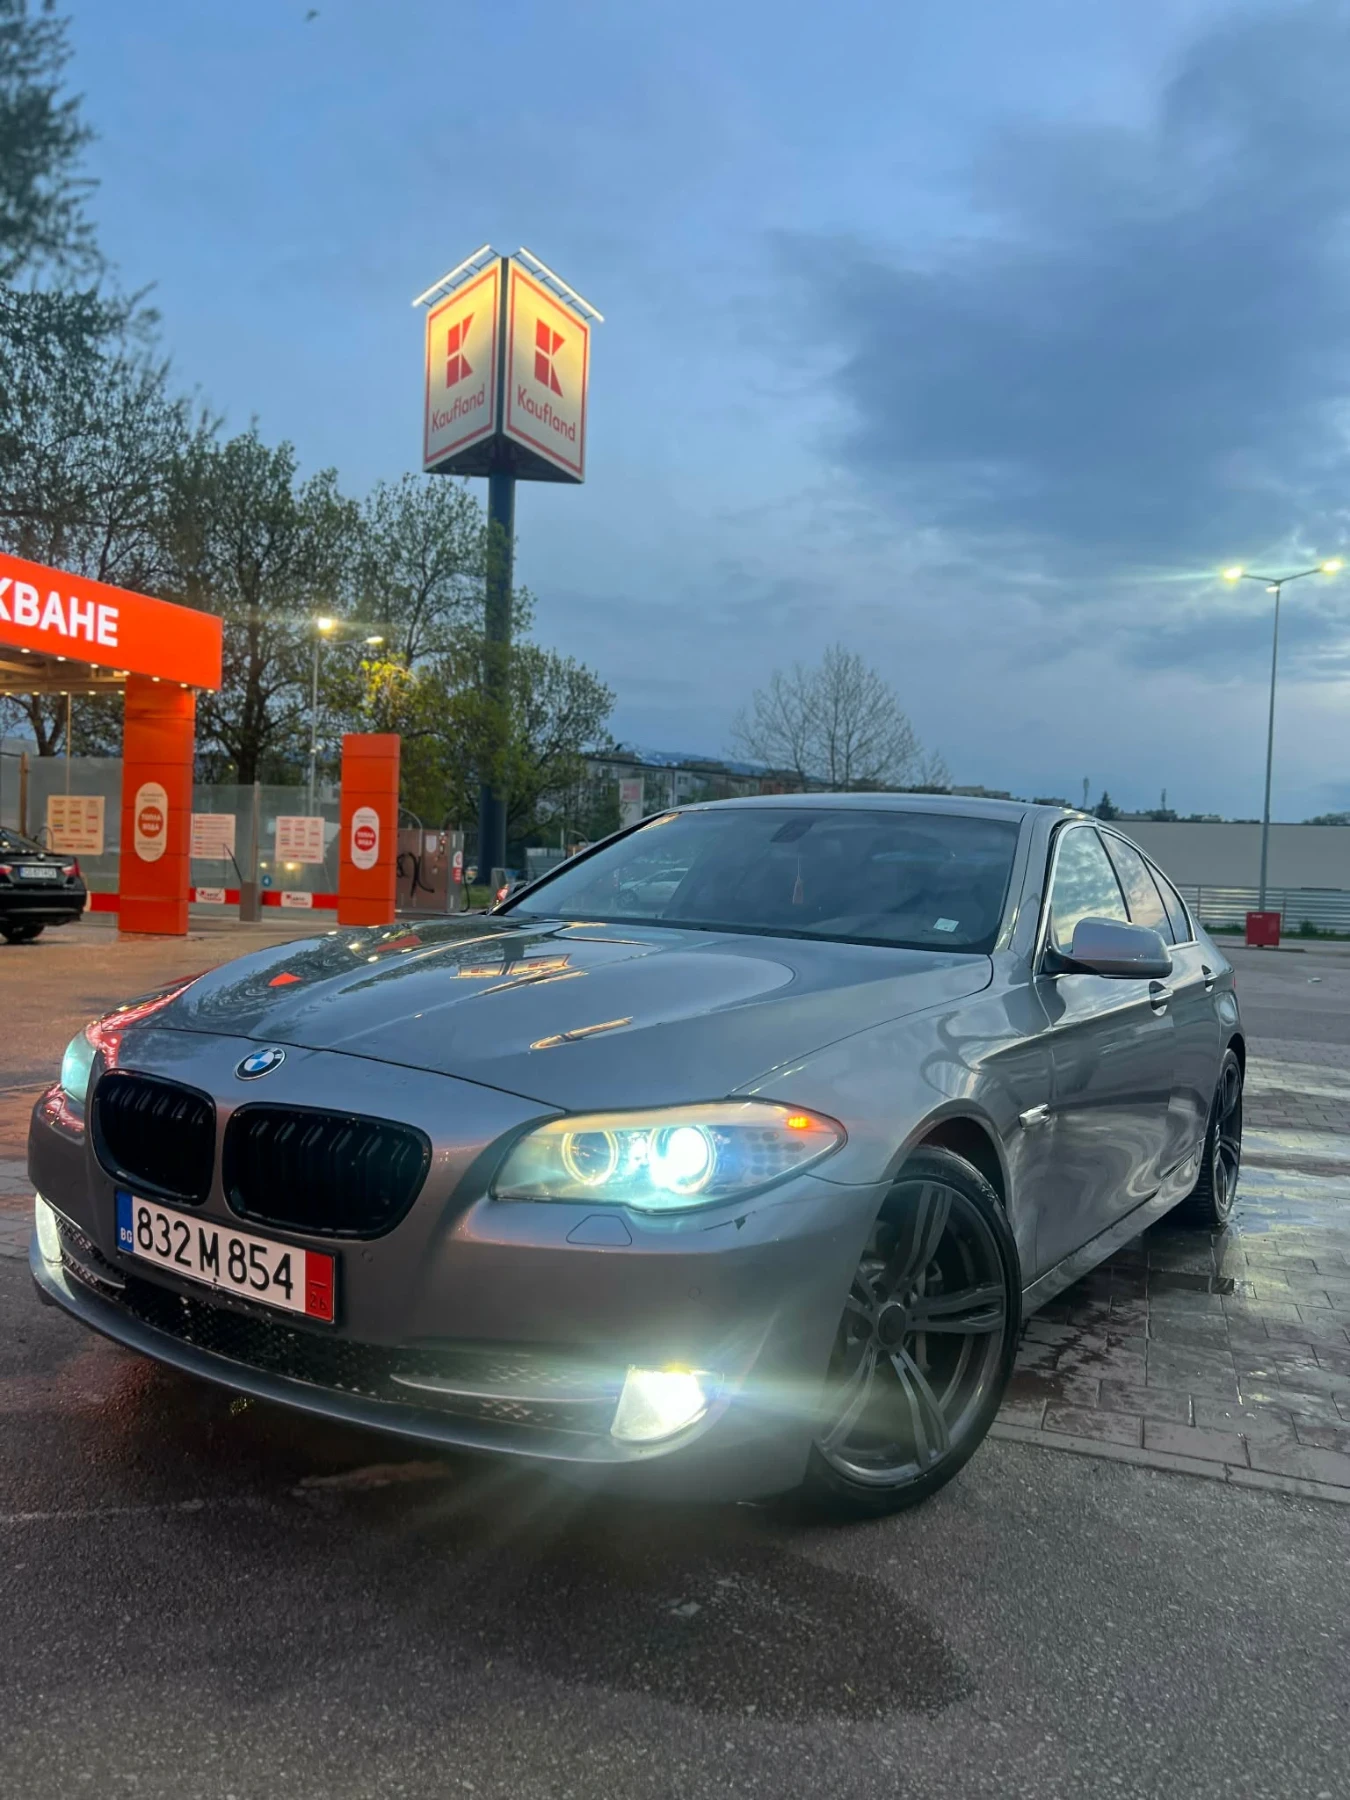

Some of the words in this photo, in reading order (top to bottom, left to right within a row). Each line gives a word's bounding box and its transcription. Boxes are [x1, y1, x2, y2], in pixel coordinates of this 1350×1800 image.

[431, 384, 485, 432] Kaufland
[517, 385, 576, 442] Kaufland
[120, 1227, 133, 1243] BG
